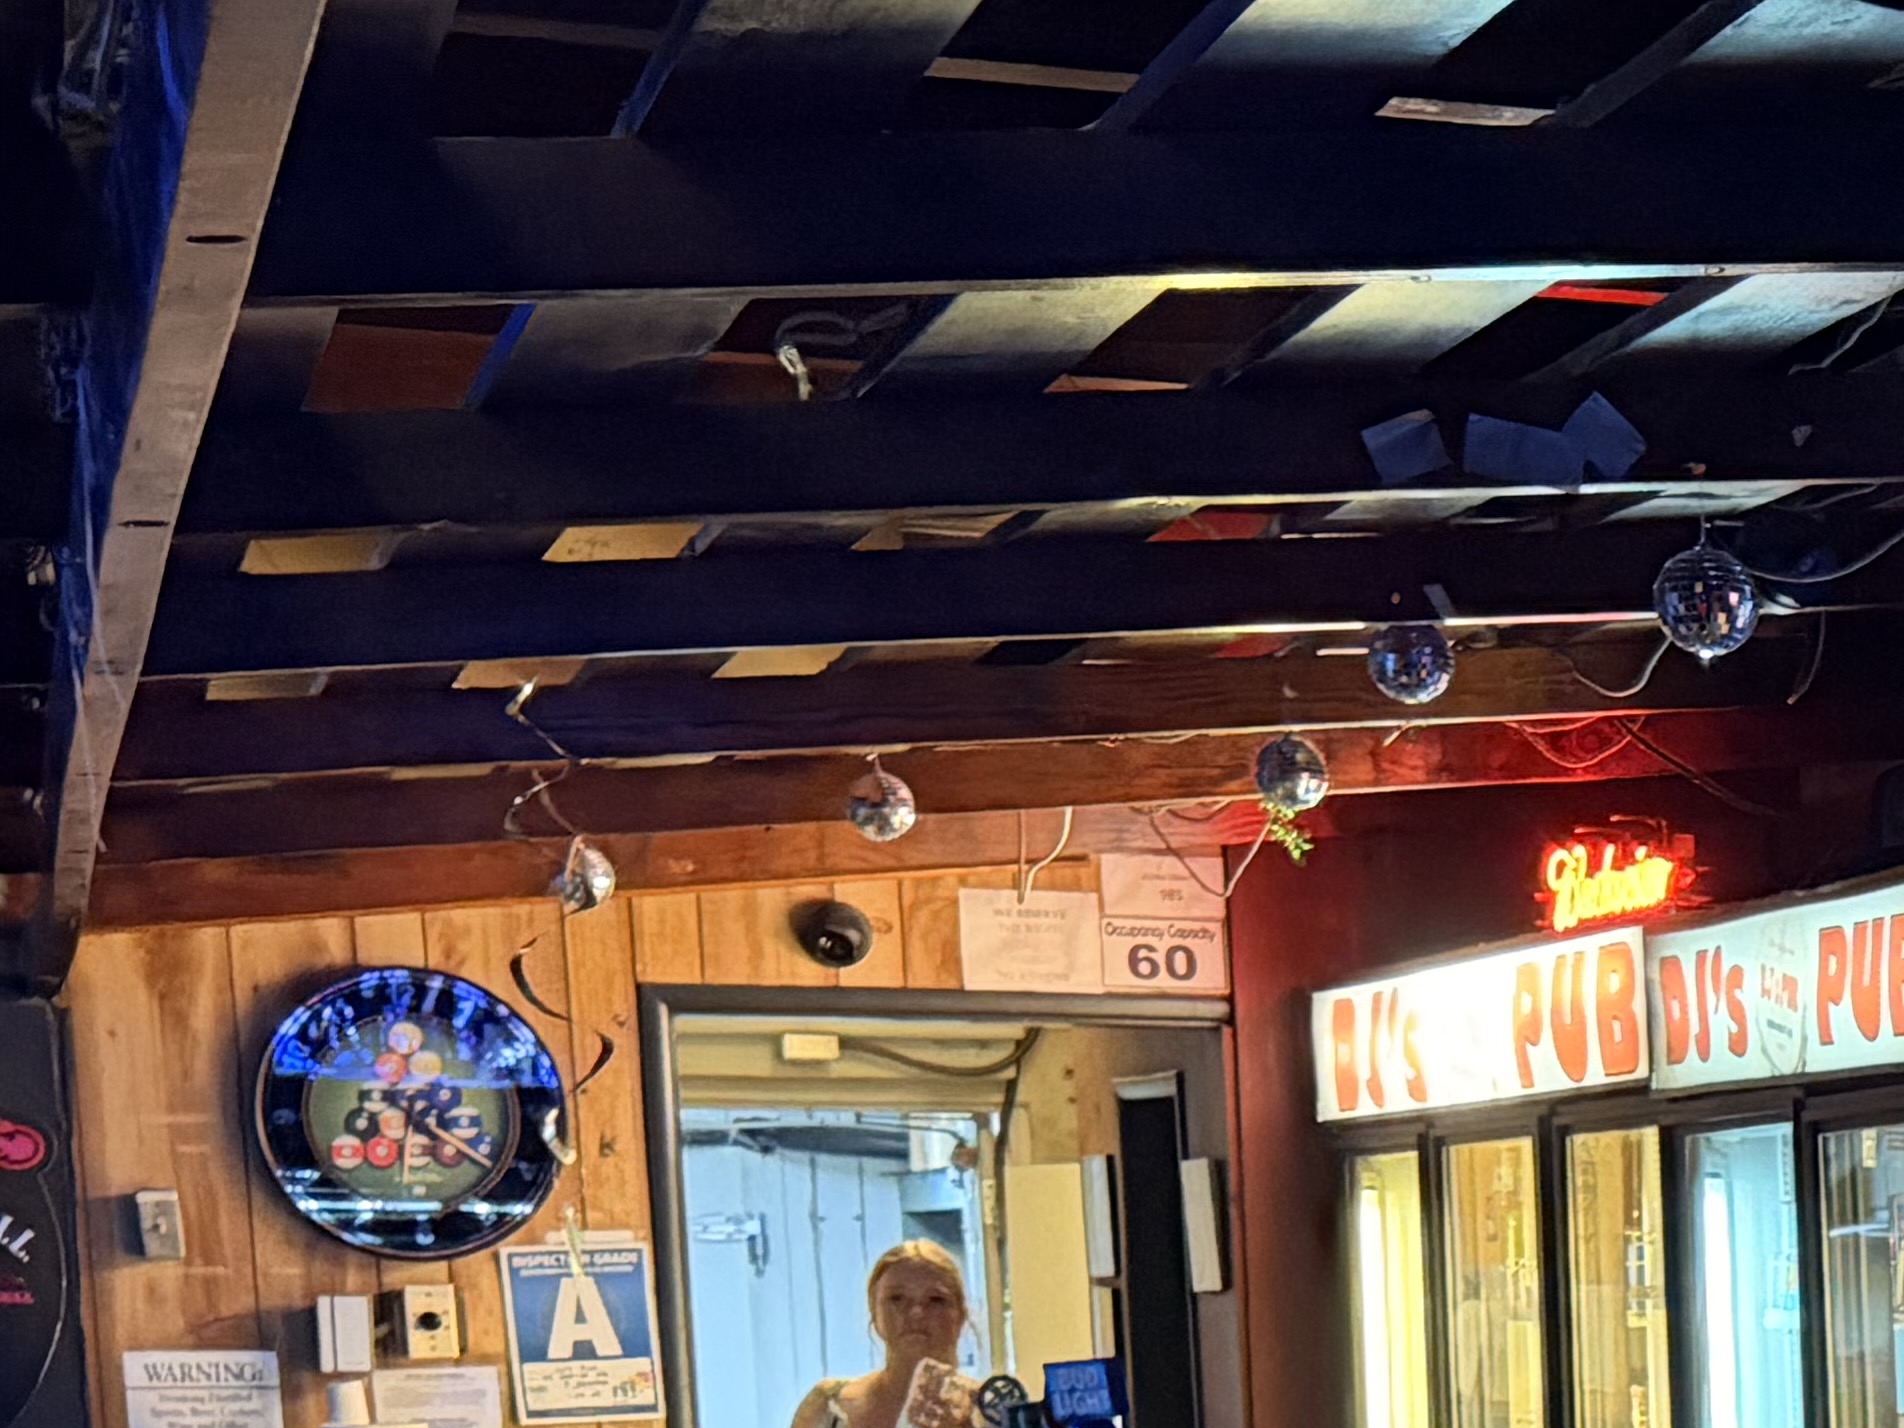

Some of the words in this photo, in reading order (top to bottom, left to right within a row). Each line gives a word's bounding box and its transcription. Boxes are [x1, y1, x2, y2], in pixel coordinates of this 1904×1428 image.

[1128, 943, 1198, 981] 60
[1512, 942, 1641, 1091] PUB
[547, 1277, 624, 1360] A
